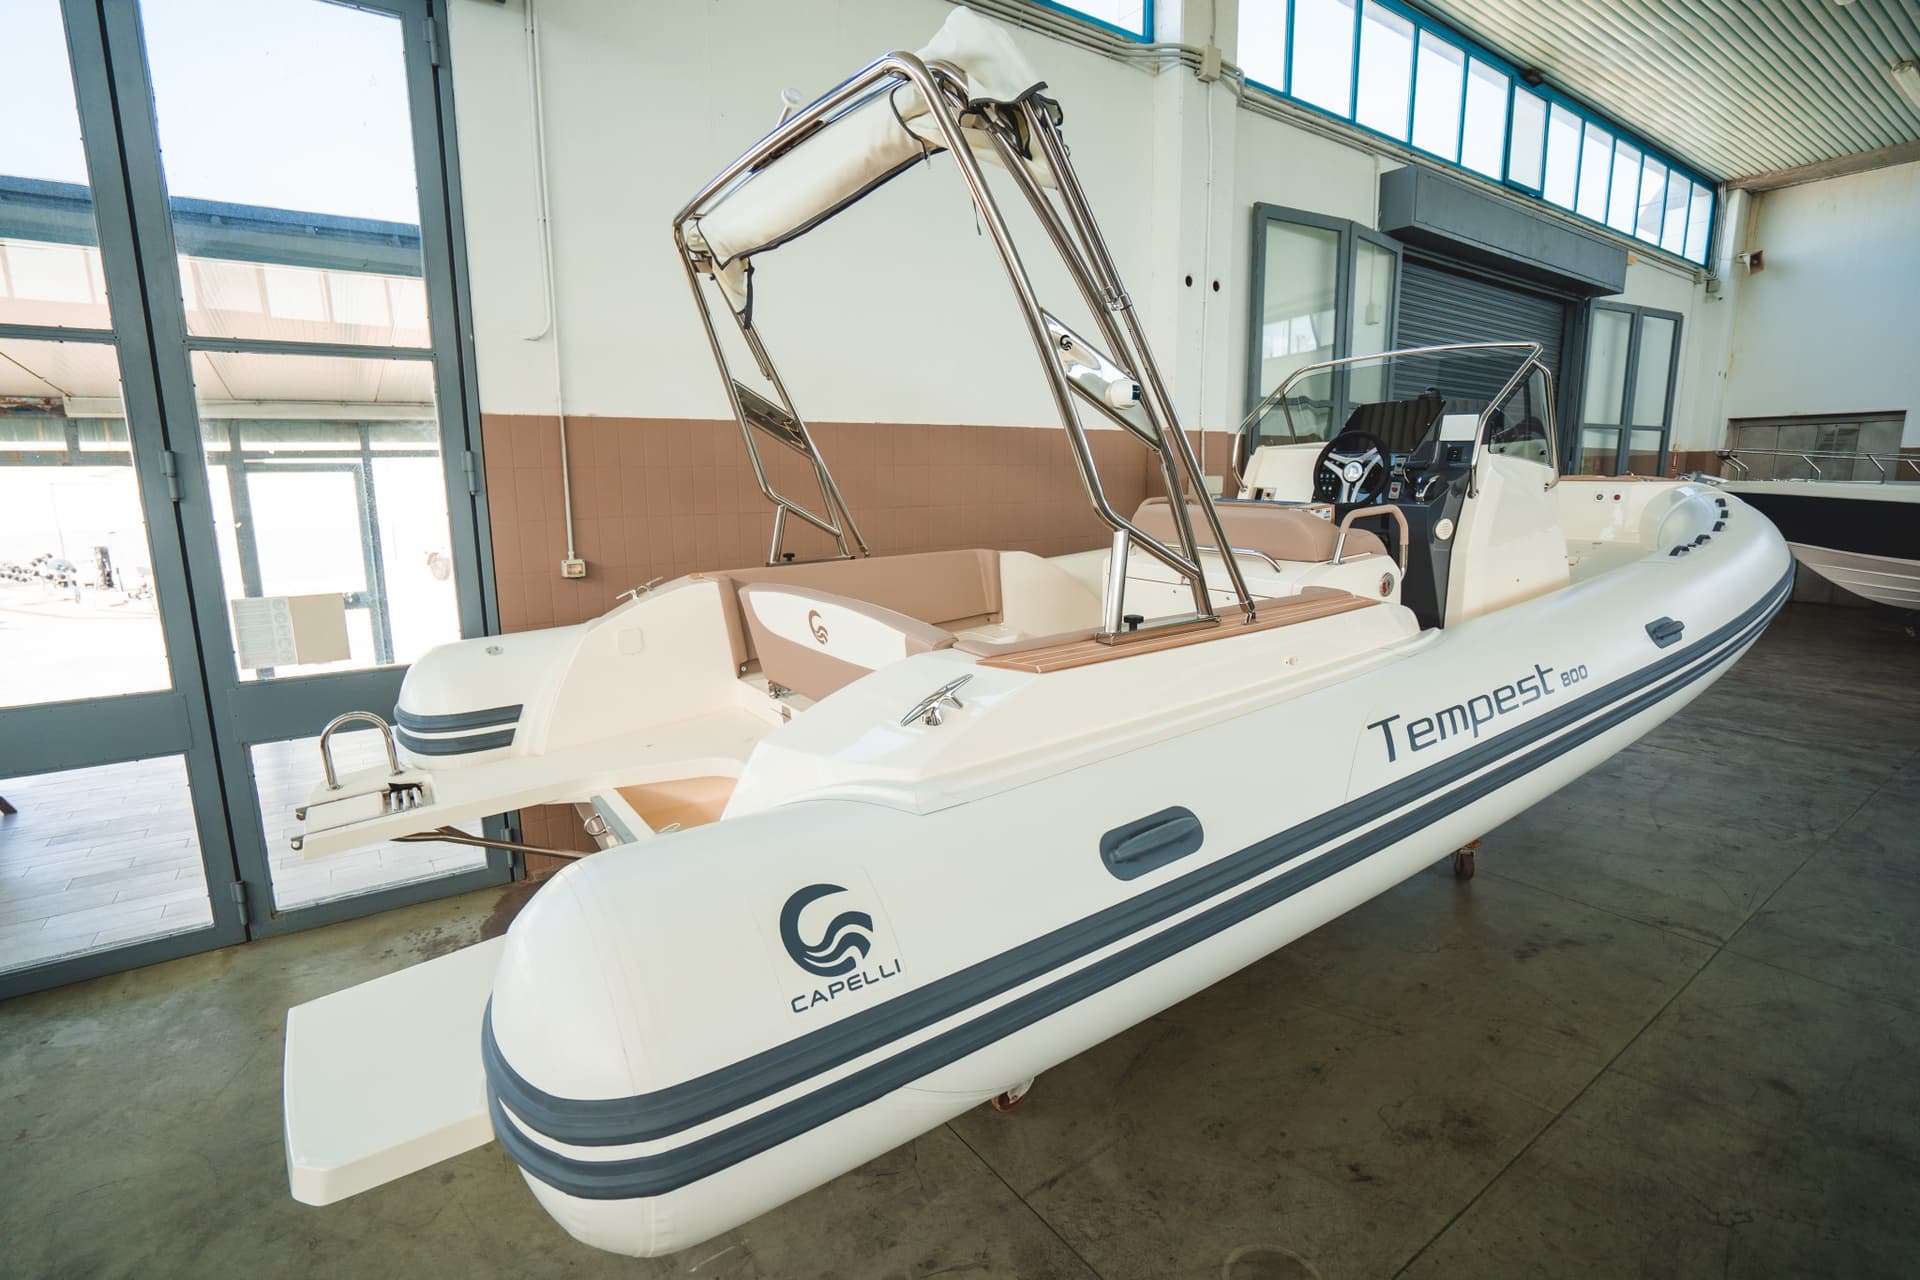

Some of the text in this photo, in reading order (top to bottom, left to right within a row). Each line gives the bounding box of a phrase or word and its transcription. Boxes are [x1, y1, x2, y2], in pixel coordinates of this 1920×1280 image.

[1366, 663, 1588, 763] Tempest 800
[790, 958, 901, 1013] CAPELLI
